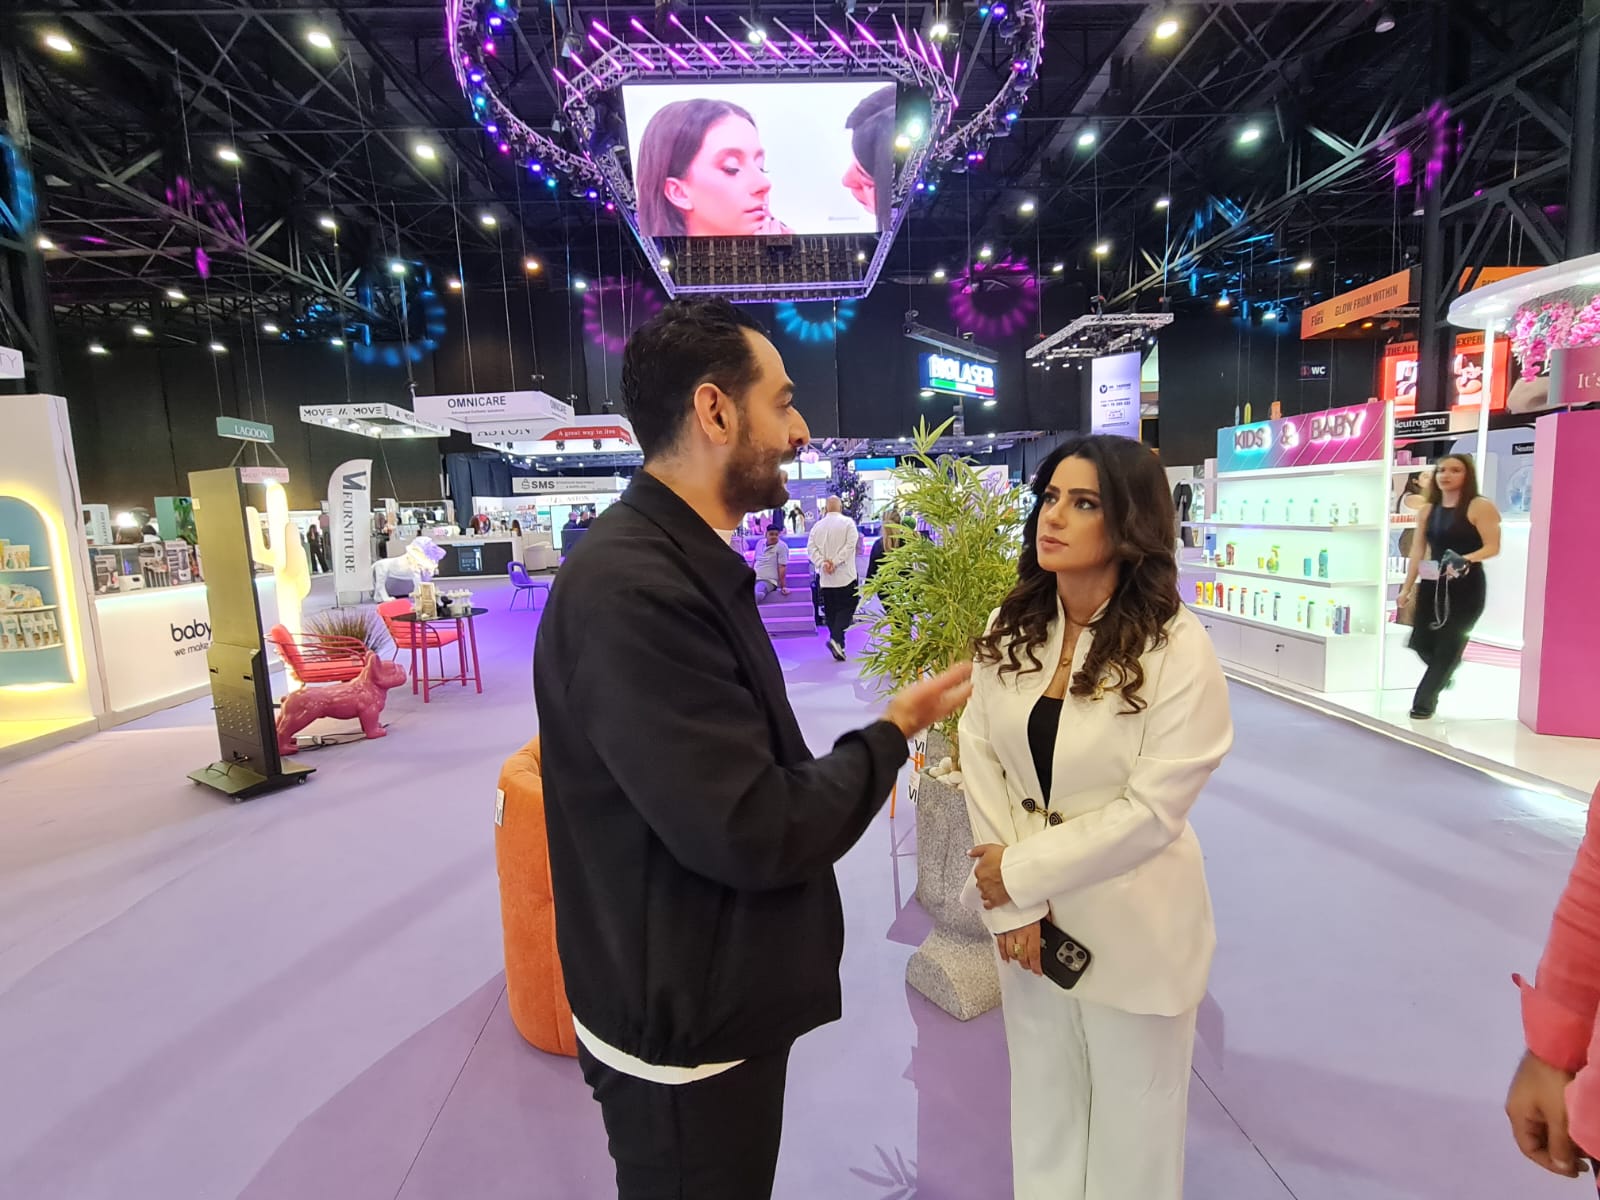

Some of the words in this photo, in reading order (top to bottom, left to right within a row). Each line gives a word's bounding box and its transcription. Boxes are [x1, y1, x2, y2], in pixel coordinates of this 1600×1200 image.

[1334, 301, 1353, 316] GLOW
[1353, 294, 1372, 310] FROM
[1372, 284, 1399, 302] WITHIN
[1311, 366, 1326, 375] WC
[447, 395, 507, 408] OMNICARE
[303, 408, 333, 417] MOVE
[353, 406, 383, 415] MOVE
[234, 424, 268, 439] LAGOON
[1234, 426, 1266, 450] KIDS
[1280, 423, 1295, 446] &
[1311, 412, 1361, 440] BABY
[531, 480, 555, 489] SMS
[342, 492, 356, 573] FURNITURE
[170, 618, 212, 642] baby
[174, 647, 186, 657] we
[187, 641, 209, 654] make
